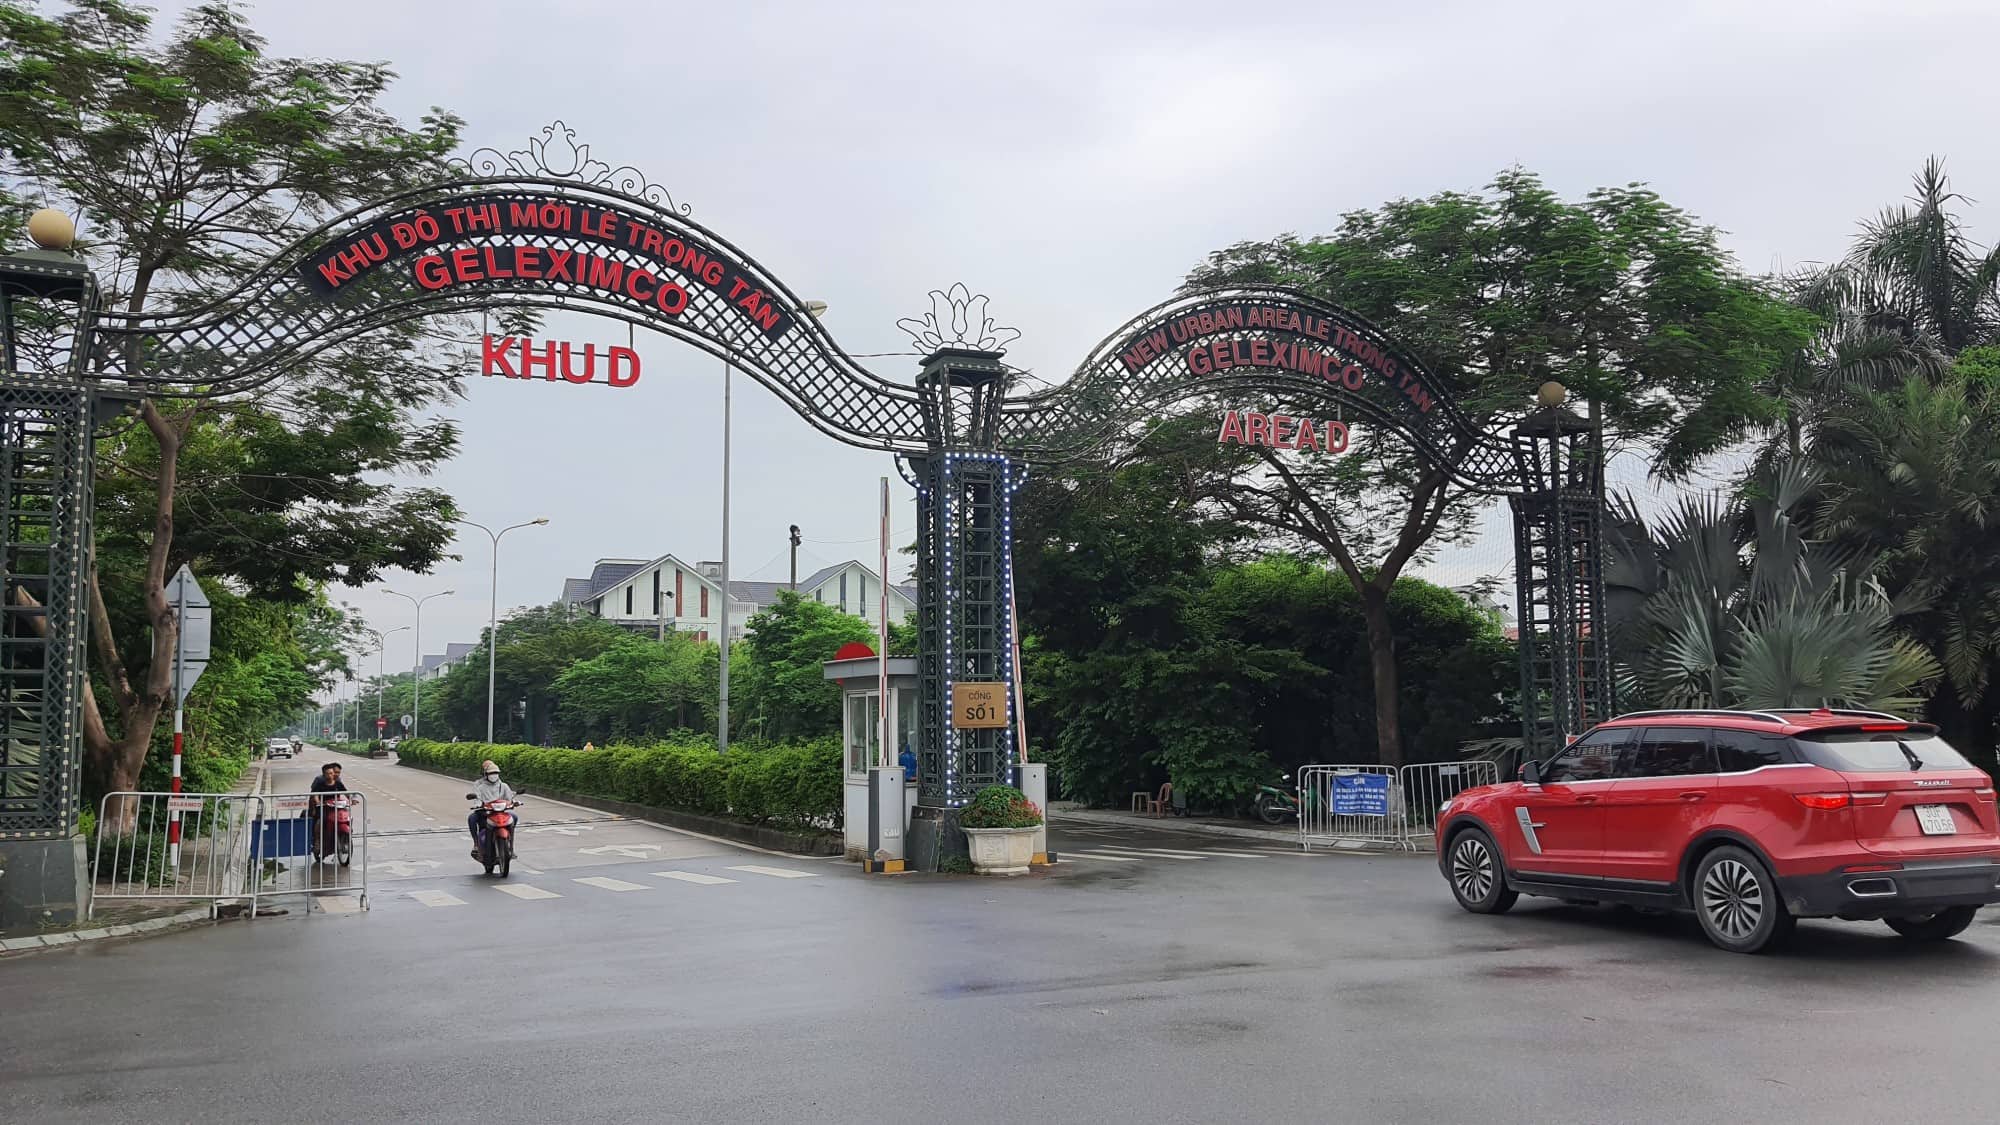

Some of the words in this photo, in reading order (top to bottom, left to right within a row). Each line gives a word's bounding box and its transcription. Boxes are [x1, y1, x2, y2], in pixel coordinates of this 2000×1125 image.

[318, 232, 388, 287] KHU
[391, 208, 440, 249] ĐÔ
[444, 203, 501, 233] THỊ
[510, 198, 571, 232] MỚI
[581, 209, 618, 240] LÊ
[627, 221, 725, 286] TRỌNG
[415, 246, 688, 314] GELEXIMCO
[482, 334, 595, 384] KHU
[608, 346, 641, 387] D
[1123, 328, 1169, 372] NEW
[1170, 307, 1243, 343] URBAN
[1247, 306, 1302, 332] AREA
[1305, 315, 1329, 340] LE
[1333, 325, 1397, 378] TRONG
[1398, 370, 1434, 413] TAN
[1188, 340, 1364, 391] GELEXIMCO
[1219, 410, 1319, 452] AREA
[1325, 420, 1349, 453] D
[966, 702, 986, 720] SỐ
[988, 706, 995, 720] 1
